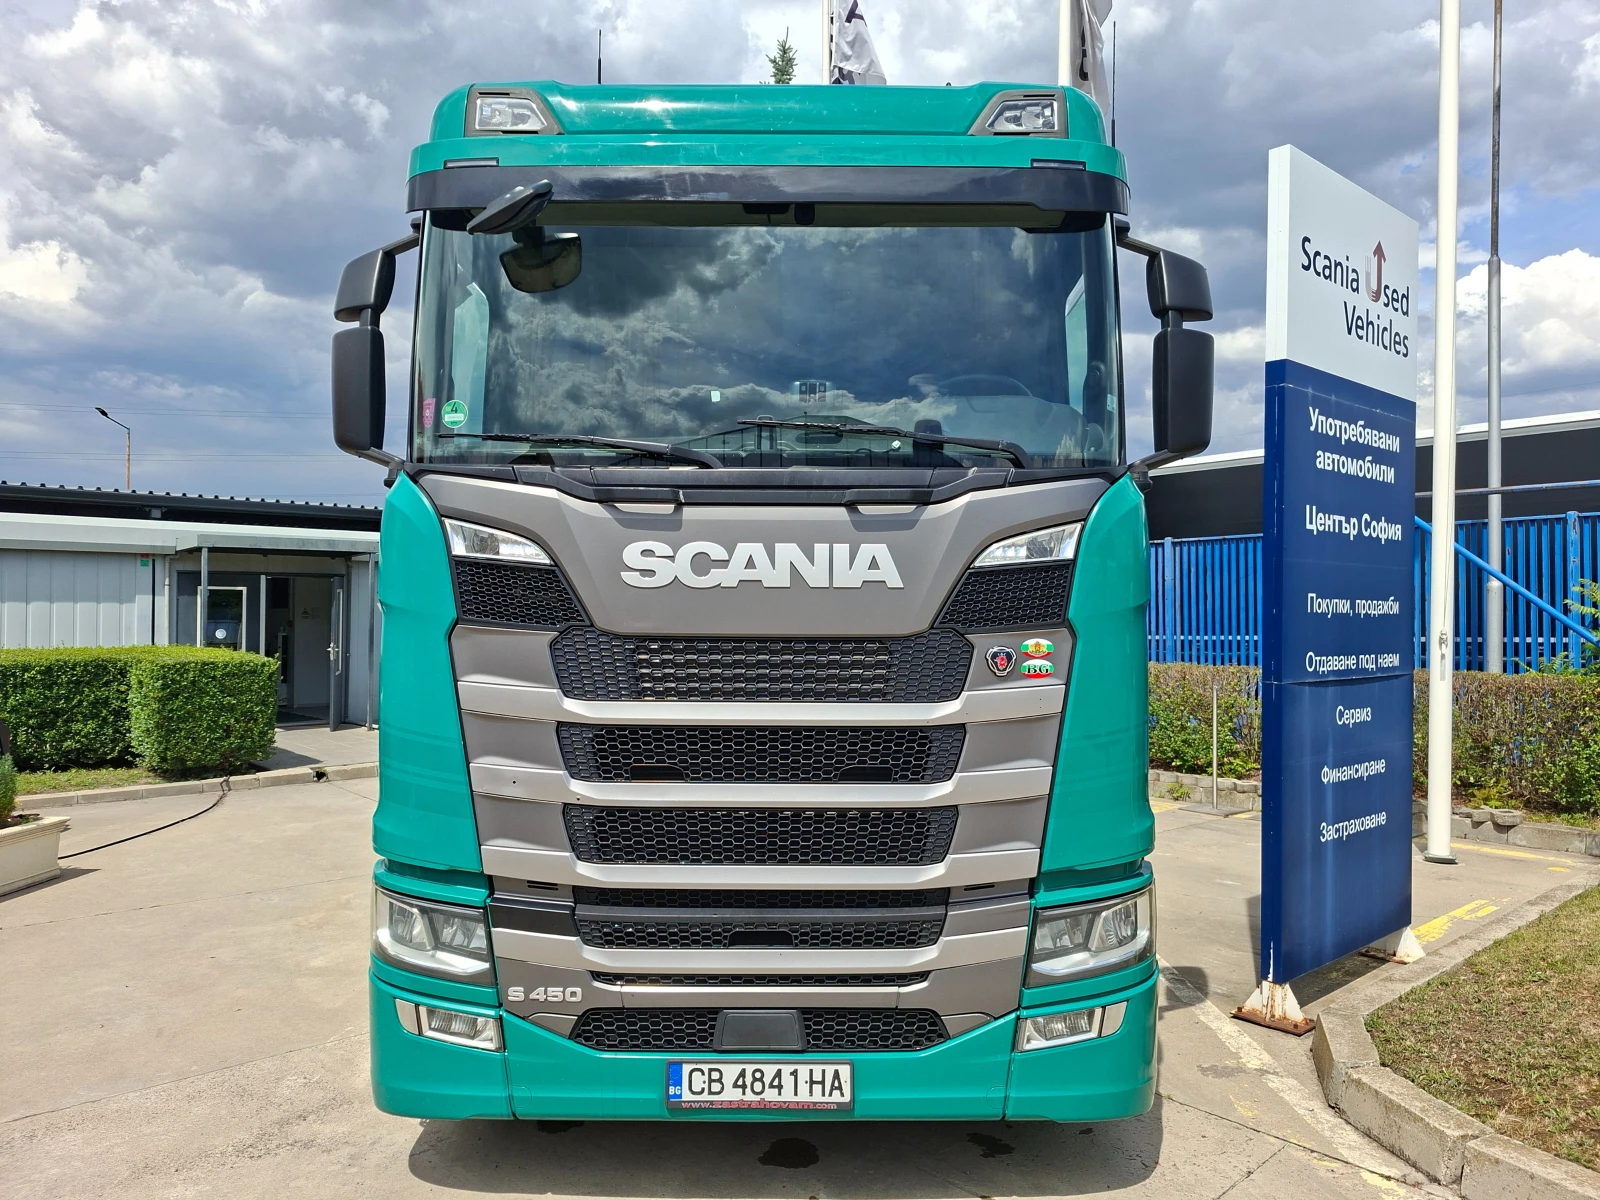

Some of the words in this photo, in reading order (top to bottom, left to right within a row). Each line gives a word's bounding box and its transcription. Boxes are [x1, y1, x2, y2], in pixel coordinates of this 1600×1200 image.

[1301, 235, 1360, 294] Scania
[1364, 240, 1410, 317] Used
[1343, 300, 1409, 358] Vehicles
[450, 401, 458, 414] 4
[1308, 406, 1400, 453] Употребявани
[1316, 450, 1395, 484] автомобили
[1305, 504, 1359, 541] Център
[1361, 513, 1402, 544] София
[620, 541, 904, 589] SCANIA
[1307, 592, 1353, 618] Покупки,
[1355, 596, 1400, 618] продажби
[1027, 663, 1050, 674] BG
[1305, 651, 1357, 674] Отдаване
[1358, 654, 1376, 671] под
[1377, 652, 1400, 668] наем
[1336, 705, 1372, 728] Сервиз
[1321, 758, 1386, 785] Финансиране
[1319, 811, 1387, 842] Застраховане
[507, 986, 525, 1002] S
[529, 986, 583, 1002] 450
[668, 1085, 682, 1095] BG
[687, 1067, 725, 1096] CB
[732, 1067, 799, 1097] 4841
[808, 1068, 845, 1097] HA
[681, 1097, 838, 1110] www.zastrahovam.com
